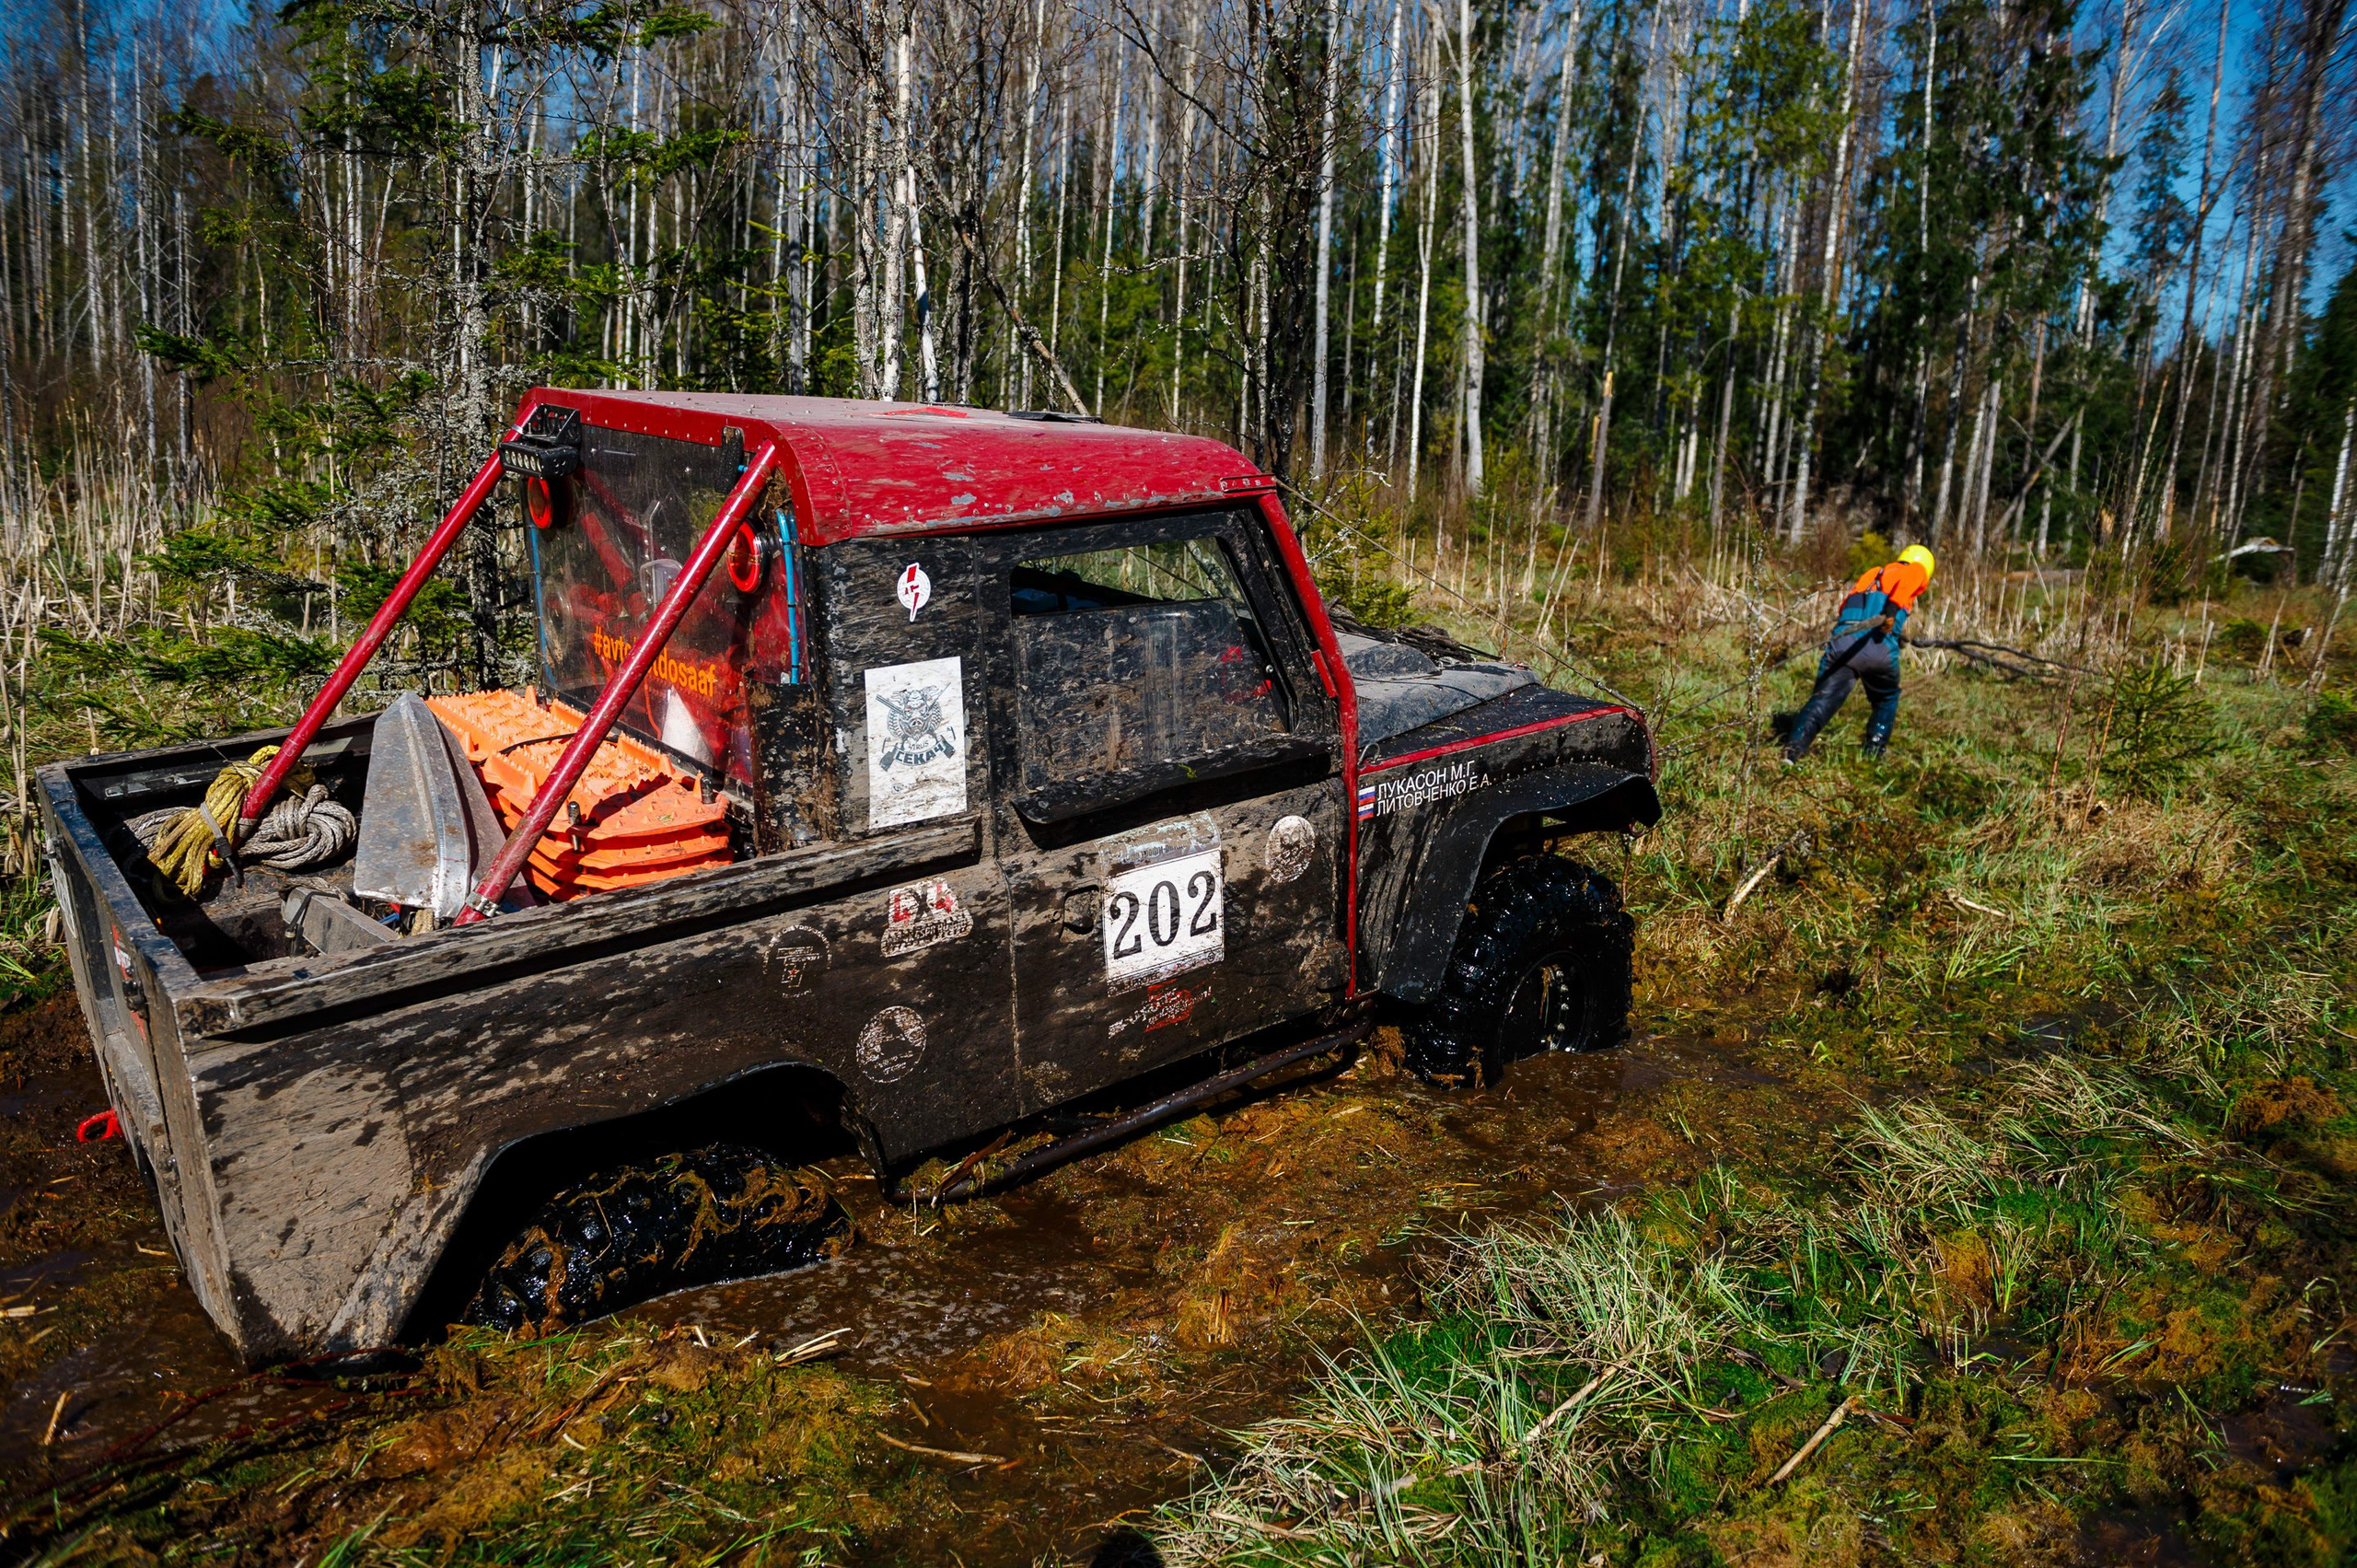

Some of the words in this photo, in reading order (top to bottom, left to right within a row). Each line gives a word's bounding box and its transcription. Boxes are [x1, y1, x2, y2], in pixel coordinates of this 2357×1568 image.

[895, 742, 946, 765] СЕКАЧ
[1376, 767, 1447, 801] ЛУКАСОН
[1450, 760, 1475, 781] М.Г.
[1376, 779, 1467, 817] ЛИТОВЧЕНКО
[1109, 870, 1217, 960] 202
